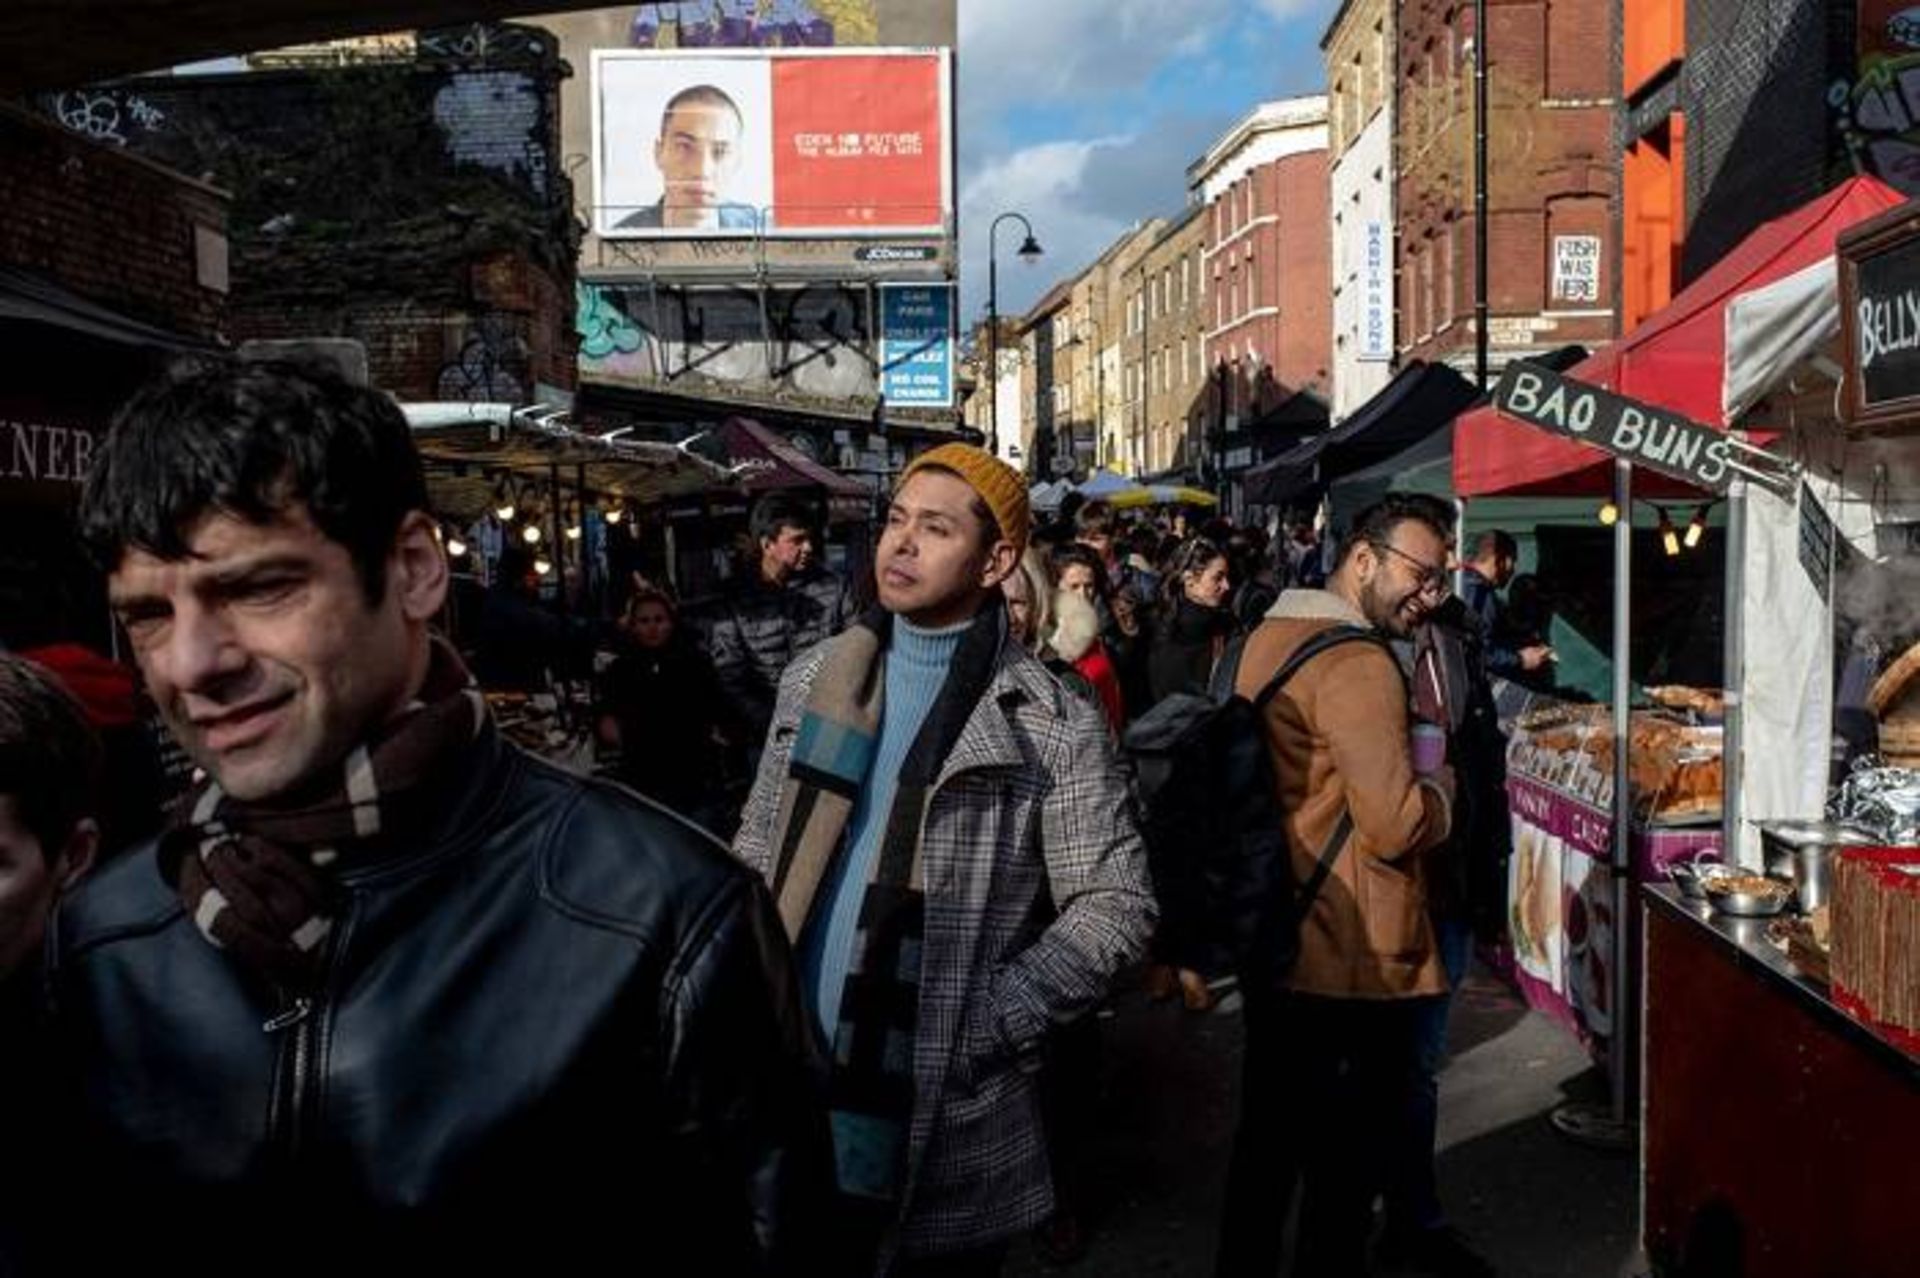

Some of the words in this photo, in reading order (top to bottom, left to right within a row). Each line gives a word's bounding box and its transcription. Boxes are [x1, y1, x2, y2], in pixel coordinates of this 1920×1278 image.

[1559, 259, 1593, 275] WAS
[1557, 279, 1594, 297] HERE
[1507, 372, 1597, 432] BAO
[1612, 407, 1731, 482] BUNS
